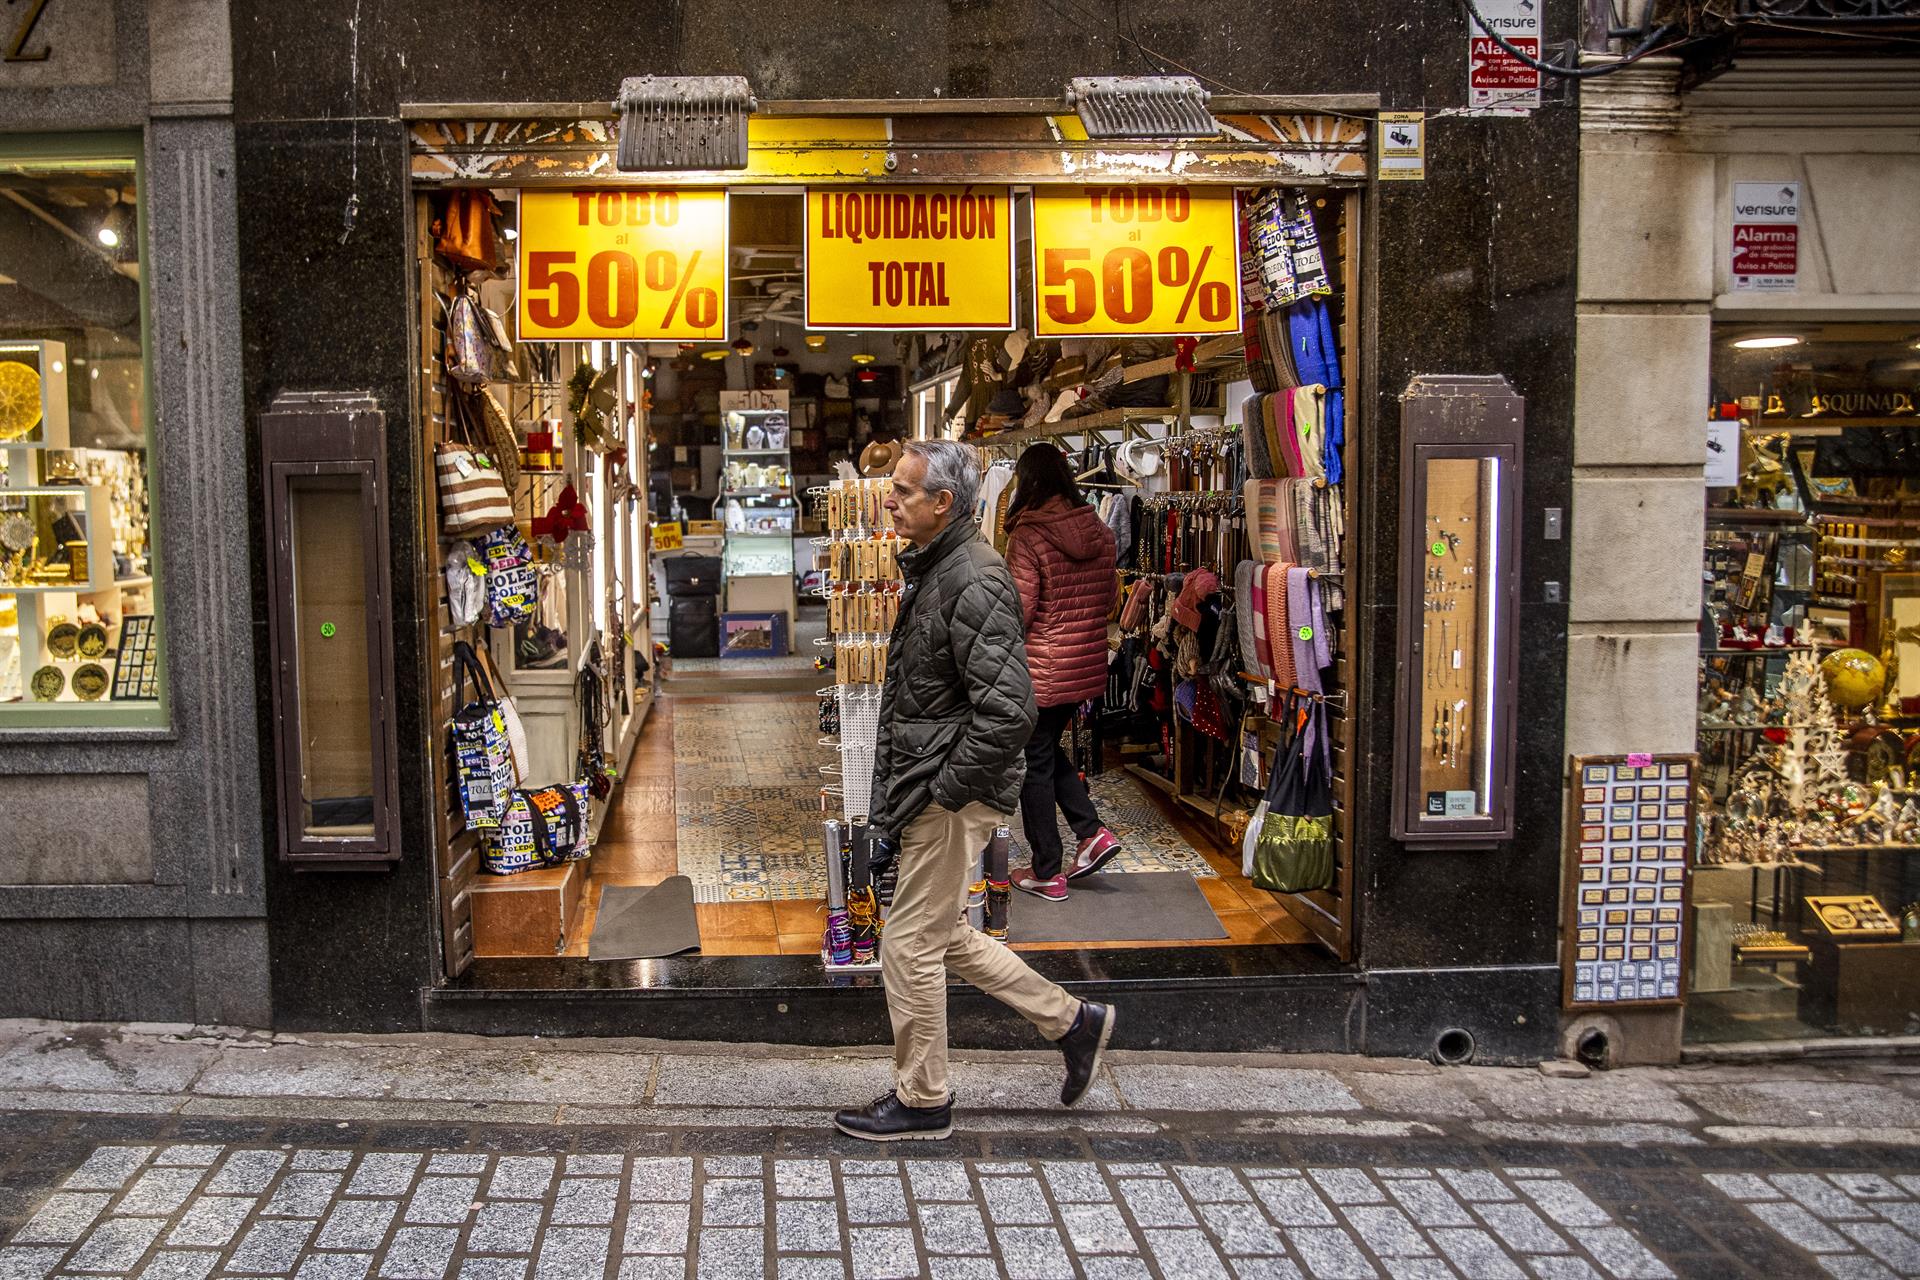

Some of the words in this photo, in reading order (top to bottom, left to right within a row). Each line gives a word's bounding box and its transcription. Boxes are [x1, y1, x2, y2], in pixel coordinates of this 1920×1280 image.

[573, 191, 679, 226] TODO
[821, 186, 996, 243] LIQUIDACIÓN
[1084, 187, 1190, 223] TODO
[616, 233, 628, 244] al
[1128, 229, 1141, 241] al
[1736, 227, 1796, 242] Alarma
[527, 250, 718, 329] 50%
[868, 262, 950, 307] TOTAL
[1044, 246, 1231, 324] 50%
[655, 535, 682, 550] 50%
